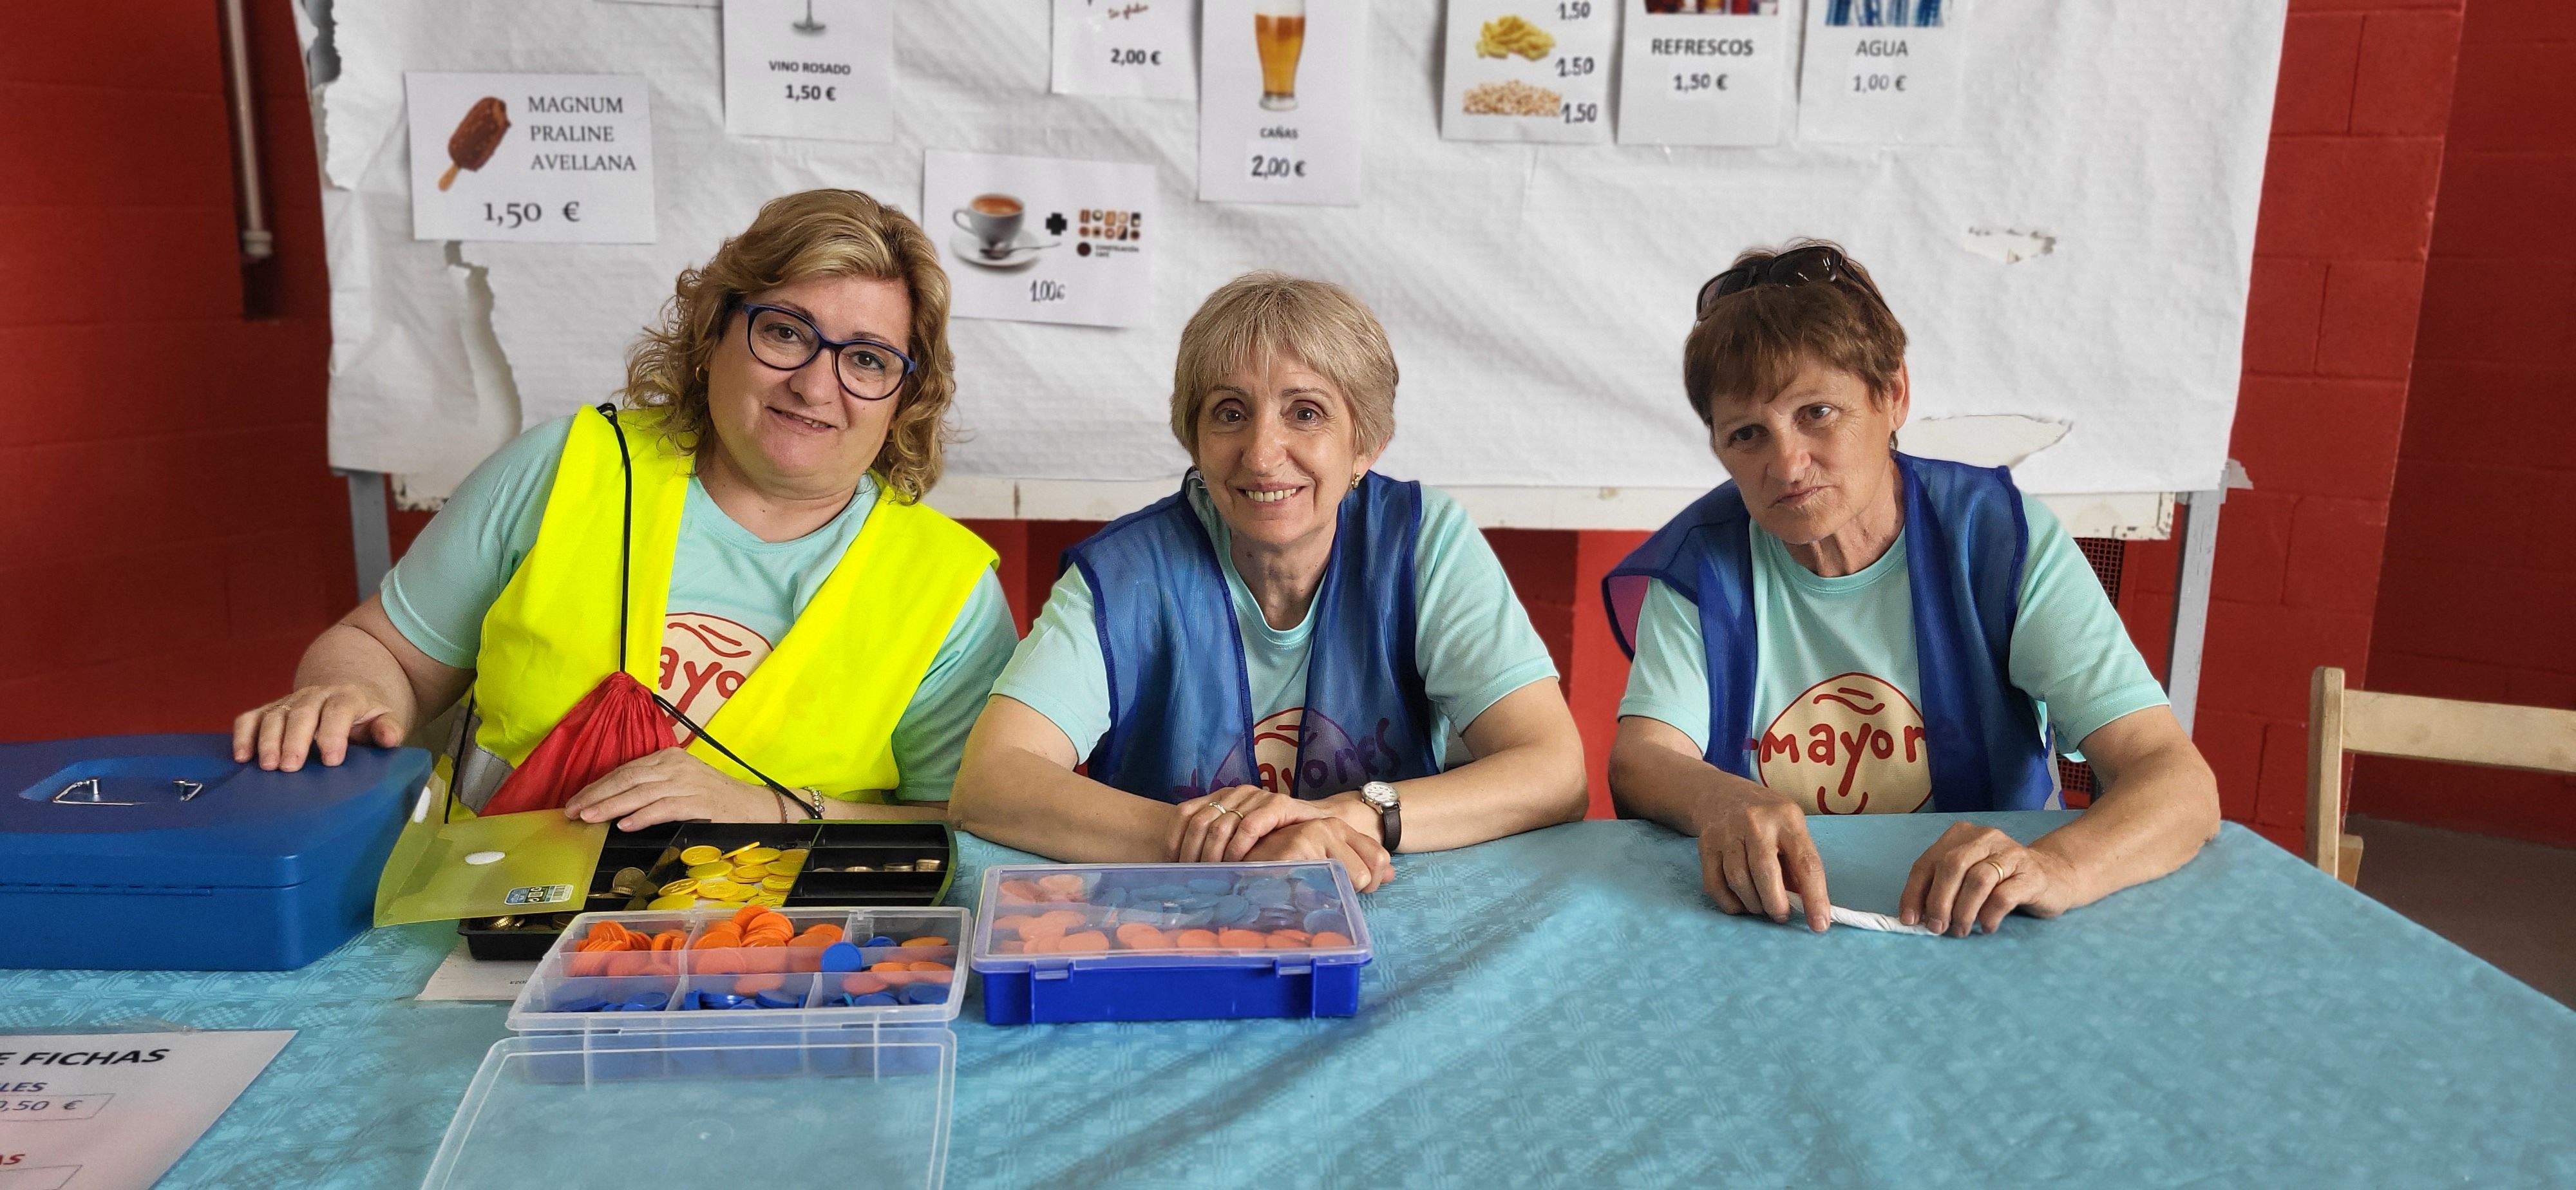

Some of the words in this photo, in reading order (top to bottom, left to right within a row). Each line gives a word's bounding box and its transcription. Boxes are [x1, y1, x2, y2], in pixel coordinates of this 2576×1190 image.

[1651, 39, 1754, 56] REFRESCOS
[1855, 40, 1909, 56] AGUA
[1110, 48, 1147, 66] 2,00
[1150, 50, 1161, 66] €
[768, 61, 800, 73] VINO
[802, 62, 851, 75] ROSADO
[1674, 73, 1711, 93] 1,50
[1716, 74, 1728, 91] €
[1853, 74, 1889, 94] 1,00
[1895, 75, 1907, 91] €
[786, 84, 822, 102] 1,50
[826, 86, 836, 101] €
[527, 96, 623, 113] MAGNUM
[530, 126, 614, 142] PRALINE
[1260, 126, 1298, 140] CAÑAS
[531, 154, 637, 171] AVELLANA
[1251, 155, 1291, 180] 2,00
[1294, 160, 1306, 177] €
[484, 202, 542, 229] 1,50
[562, 201, 580, 222] €
[1743, 722, 1926, 797] mayor
[19, 1048, 171, 1066] FICHAS
[62, 1100, 83, 1111] €
